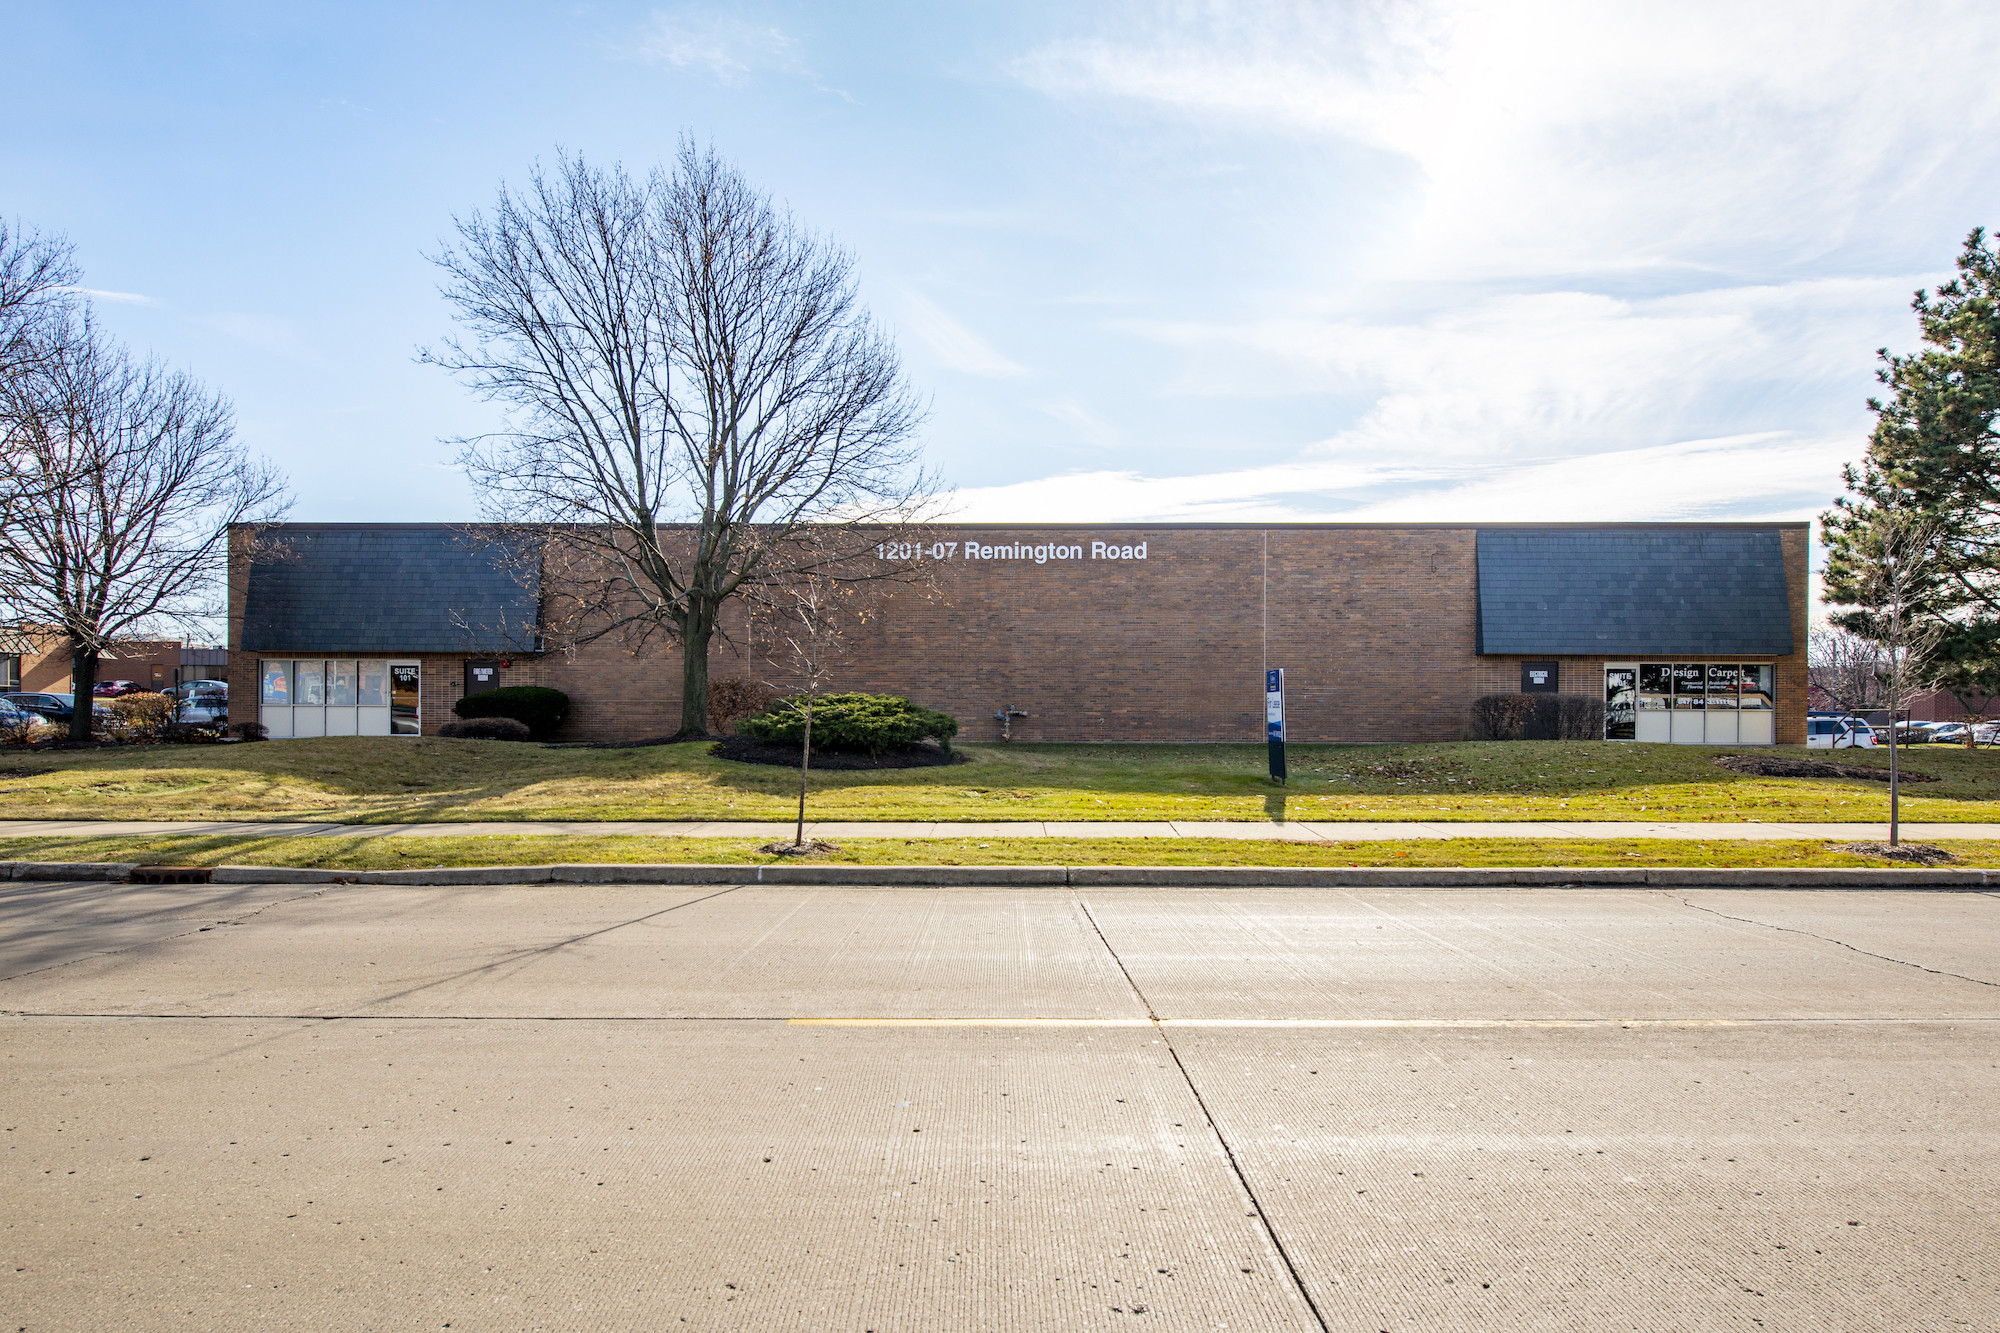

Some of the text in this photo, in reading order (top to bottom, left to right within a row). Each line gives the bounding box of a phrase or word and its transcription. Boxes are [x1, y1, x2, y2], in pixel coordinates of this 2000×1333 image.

[875, 541, 1147, 564] 1201-07 Remington Road
[1661, 667, 1745, 679] Design Carpet
